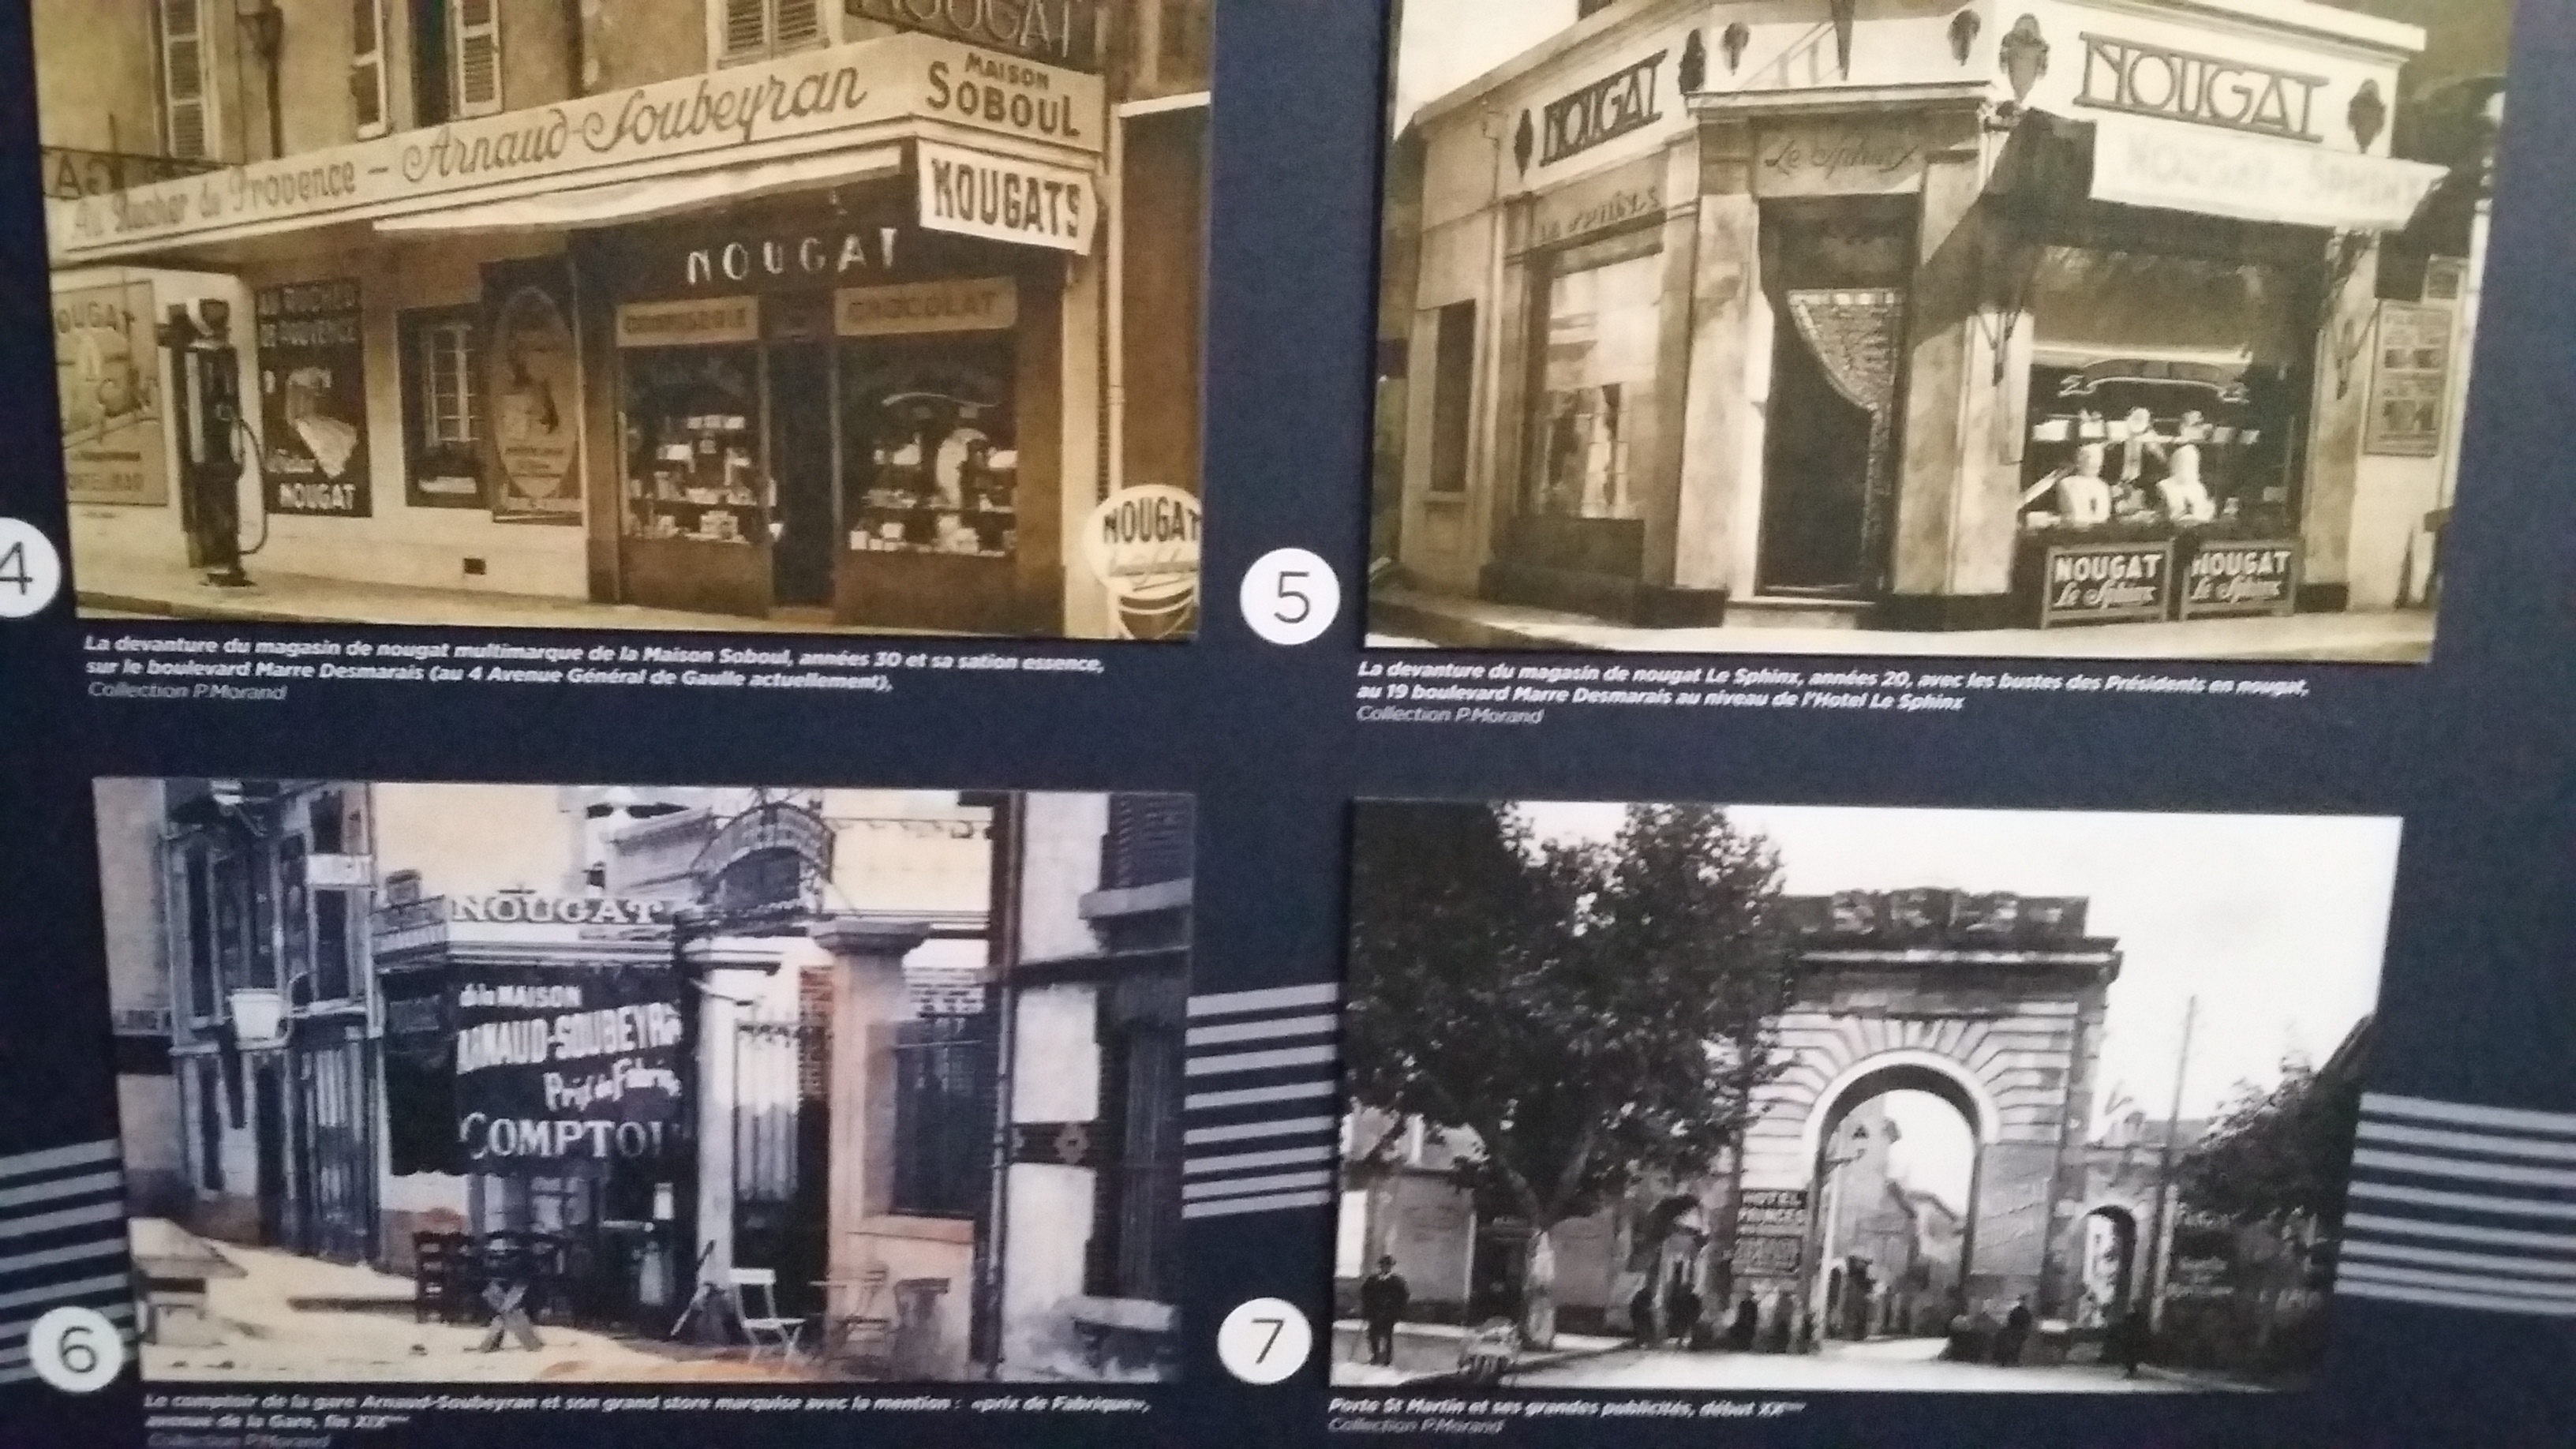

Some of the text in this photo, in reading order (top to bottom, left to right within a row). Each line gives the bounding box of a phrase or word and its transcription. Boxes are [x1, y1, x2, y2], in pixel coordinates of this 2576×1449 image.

[965, 52, 1050, 90] MAISON
[2073, 32, 2331, 144] NOUGAT
[926, 61, 1080, 137] SOBOUL
[1540, 49, 1668, 167] NOUGAT
[228, 161, 356, 214] Provence
[931, 157, 1080, 238] NOUGATS
[687, 228, 897, 285] NOUGAT
[56, 301, 136, 333] OUGAT
[279, 482, 356, 511] NOUGAT
[1103, 496, 1203, 544] NOUGAT
[0, 541, 33, 595] 4
[2054, 554, 2163, 582] NOUGAT
[2191, 551, 2293, 578] NOUGAT
[1274, 571, 1310, 624] 5
[84, 635, 110, 651] La
[114, 635, 219, 653] devanture
[223, 638, 251, 654] du
[255, 639, 341, 657] magasin
[346, 640, 373, 657] de
[376, 643, 450, 660] nougat
[453, 642, 583, 662] multimarque
[588, 645, 615, 662] de
[619, 646, 638, 661] la
[642, 646, 713, 665] Maison
[719, 647, 794, 668] Soboul,
[799, 650, 869, 668] années
[874, 651, 902, 668] 30
[905, 652, 926, 669] et
[930, 653, 953, 670] sa
[957, 653, 1018, 671] sation
[86, 662, 119, 675] sur
[122, 659, 144, 675] le
[147, 659, 252, 676] boulevard
[255, 661, 315, 678] Marre
[319, 663, 425, 680] Desmarais
[429, 665, 464, 682] (au
[468, 666, 484, 681] 4
[485, 666, 564, 683] Avenue
[566, 668, 646, 685] Général
[650, 670, 677, 686] de
[681, 670, 746, 687] Gaulle
[88, 681, 189, 698] Collection
[1357, 661, 1383, 677] La
[1387, 661, 1485, 679] devanture
[1488, 663, 1515, 680] du
[1518, 665, 1601, 683] magasin
[1603, 665, 1631, 682] de
[1633, 668, 1702, 685] nougat
[1705, 668, 1731, 685] Le
[1733, 668, 1804, 687] Sphinx,
[1808, 668, 1878, 687] années
[1881, 671, 1913, 688] 20,
[1917, 673, 1964, 689] avec
[1965, 672, 1997, 690] les
[1998, 672, 2065, 691] bustes
[2065, 674, 2102, 691] des
[2104, 675, 2207, 693] Présidents
[2208, 680, 2234, 694] en
[1357, 685, 1382, 699] au
[1386, 683, 1410, 700] 19
[1410, 684, 1511, 701] boulevard
[1512, 687, 1569, 703] Marre
[1571, 687, 1673, 706] Desmarais
[1676, 691, 1701, 706] au
[1704, 690, 1769, 707] niveau
[1772, 691, 1799, 708] de
[1869, 693, 1895, 710] Le
[1897, 694, 1965, 711] Sphinx
[1357, 706, 1452, 722] Collection
[451, 894, 665, 924] NOUGAT
[496, 985, 582, 1007] MAISON
[458, 1110, 677, 1159] COMPTOI
[59, 1326, 97, 1373] 6
[1251, 1318, 1285, 1364] 7
[804, 1397, 849, 1412] avec
[873, 1396, 951, 1412] mention
[1021, 1396, 1050, 1412] de
[1328, 1398, 1380, 1413] Porte
[1383, 1398, 1404, 1414] St
[1406, 1398, 1467, 1414] Martin
[1468, 1399, 1490, 1414] et
[1524, 1400, 1599, 1417] grandes
[1698, 1400, 1756, 1417] début
[1327, 1417, 1418, 1433] Collection
